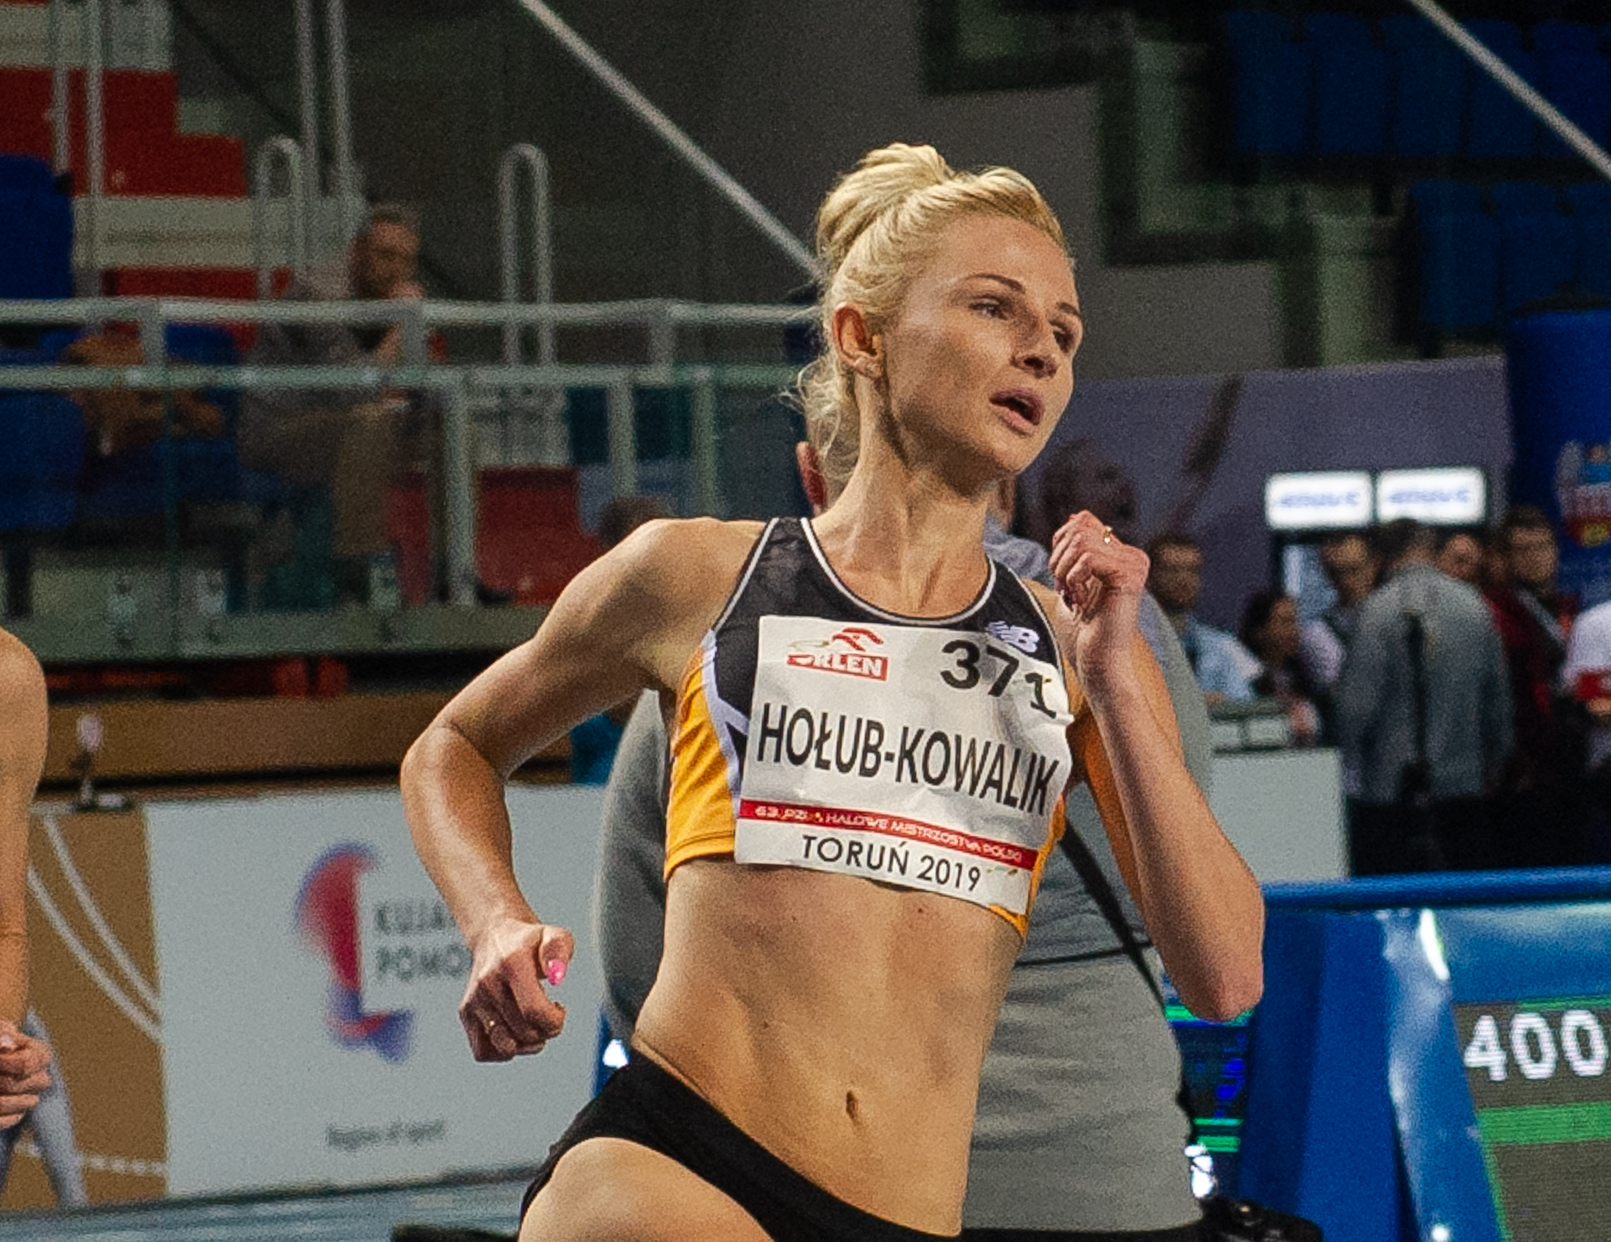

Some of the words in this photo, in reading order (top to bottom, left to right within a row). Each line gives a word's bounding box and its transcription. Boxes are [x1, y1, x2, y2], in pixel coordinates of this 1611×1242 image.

[940, 639, 1057, 719] 371
[756, 702, 1059, 816] HOŁUB-KOWALIK
[803, 834, 909, 876] TORUŃ
[916, 854, 981, 892] 2019
[1463, 1009, 1610, 1082] 400
